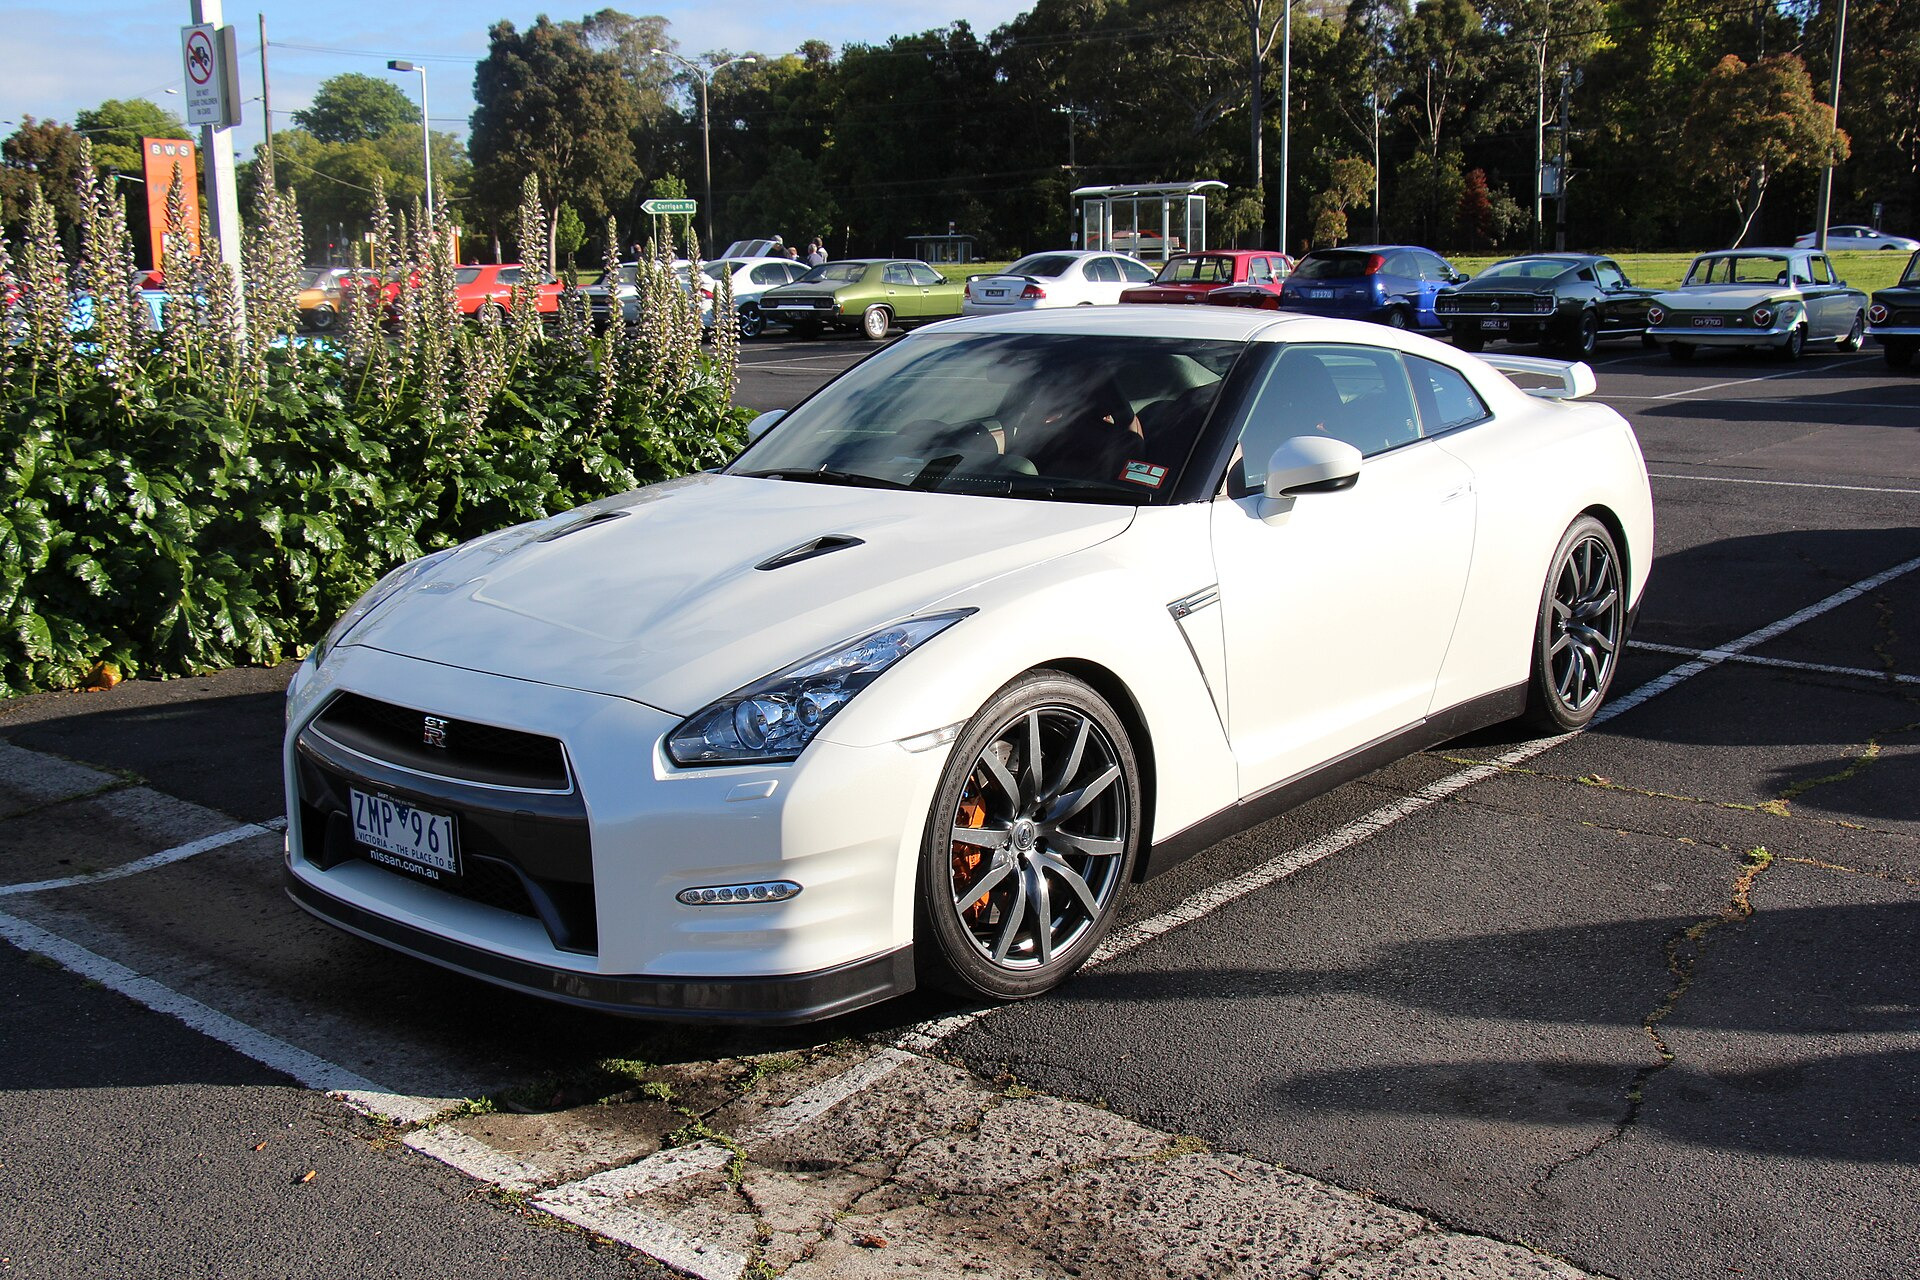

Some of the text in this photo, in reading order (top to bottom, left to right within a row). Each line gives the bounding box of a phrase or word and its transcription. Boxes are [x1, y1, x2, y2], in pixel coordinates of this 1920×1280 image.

[151, 144, 190, 157] BWS
[656, 203, 684, 211] Corrigan
[1311, 290, 1332, 298] ST170
[354, 792, 453, 859] ZMP 961
[358, 832, 388, 849] VICTORIA
[396, 844, 408, 856] THE
[411, 849, 432, 864] PLACE
[434, 856, 445, 867] TO
[370, 848, 439, 880] nissan.com.au
